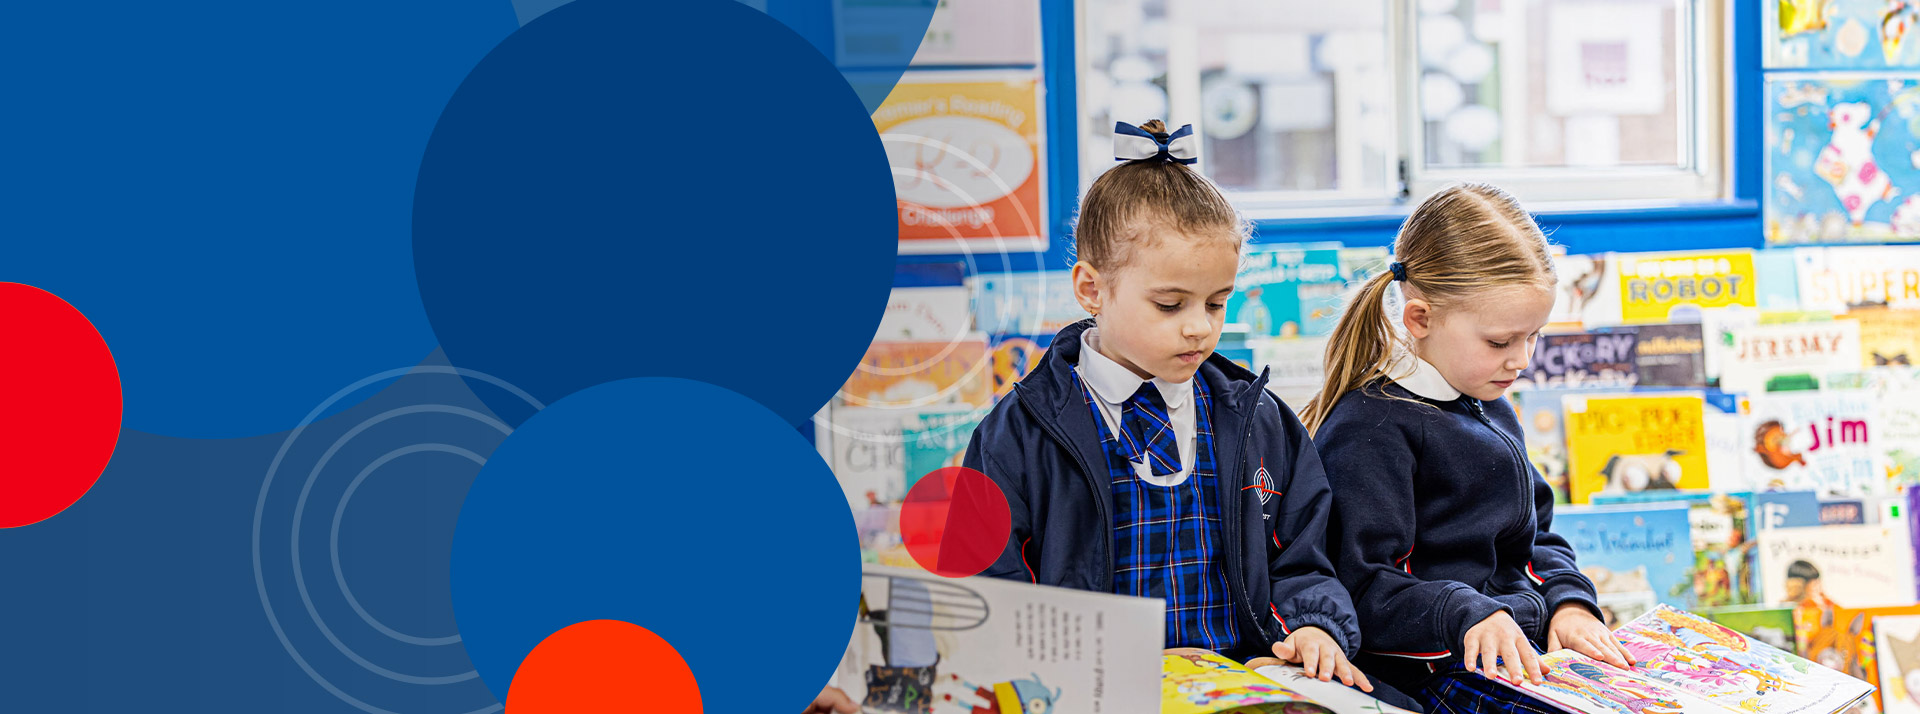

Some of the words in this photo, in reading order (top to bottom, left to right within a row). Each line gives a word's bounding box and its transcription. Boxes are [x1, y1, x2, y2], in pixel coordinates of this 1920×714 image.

[901, 205, 995, 229] Challenge
[1629, 276, 1742, 301] ROBOT
[1529, 335, 1634, 374] ICKORY
[1738, 332, 1843, 361] JEREMY
